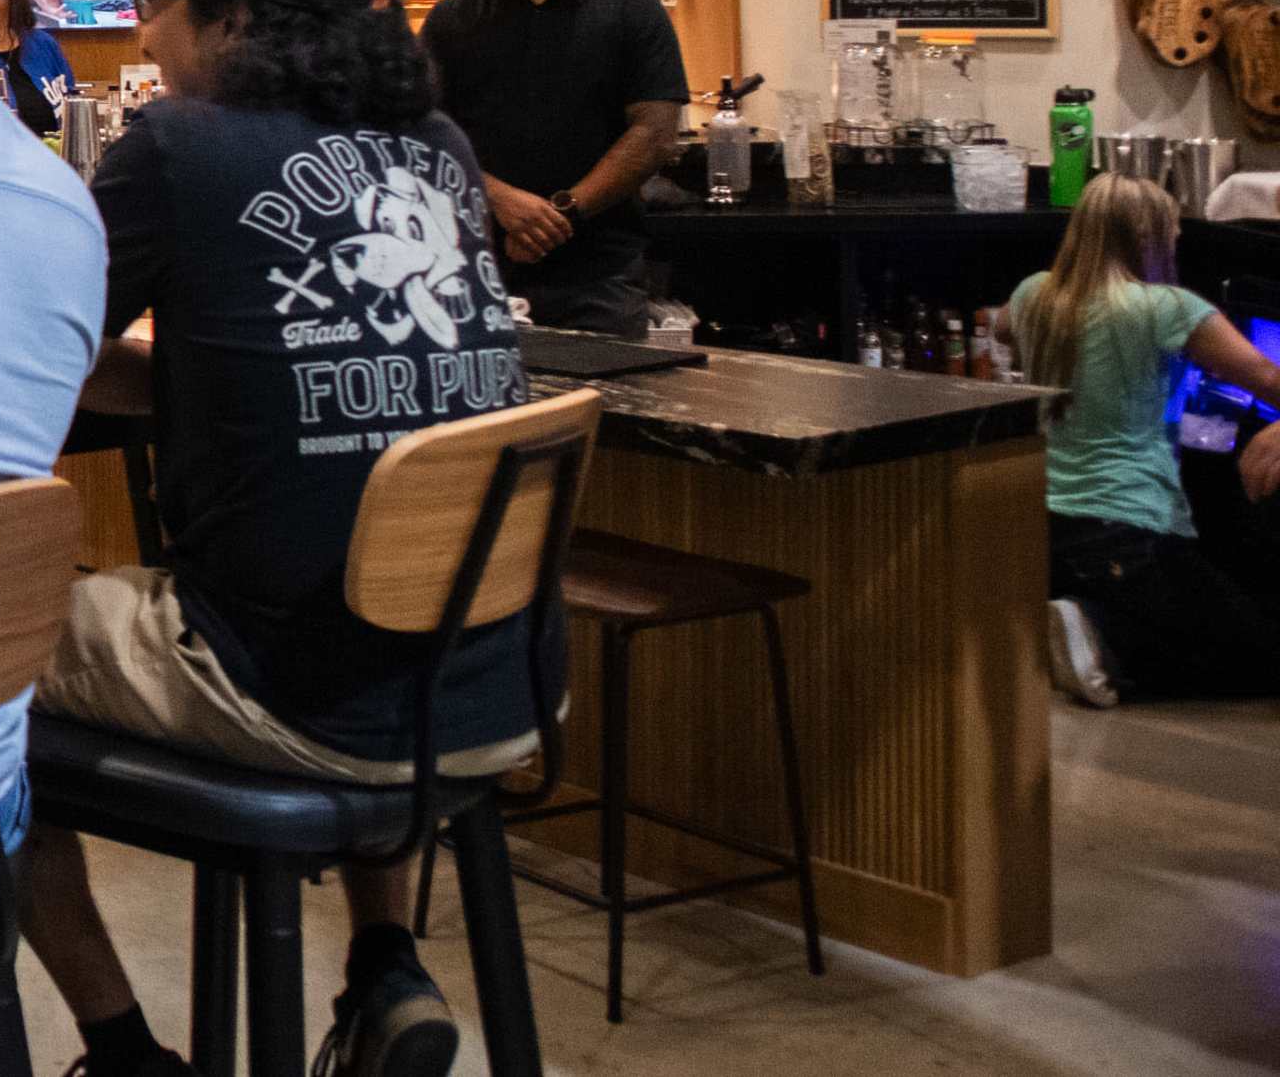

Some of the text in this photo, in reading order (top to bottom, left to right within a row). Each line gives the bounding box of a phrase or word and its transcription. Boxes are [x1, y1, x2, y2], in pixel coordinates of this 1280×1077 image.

[282, 316, 364, 349] Trade
[292, 358, 423, 423] FOR
[298, 434, 362, 455] BROUGHT
[366, 431, 385, 451] TO
